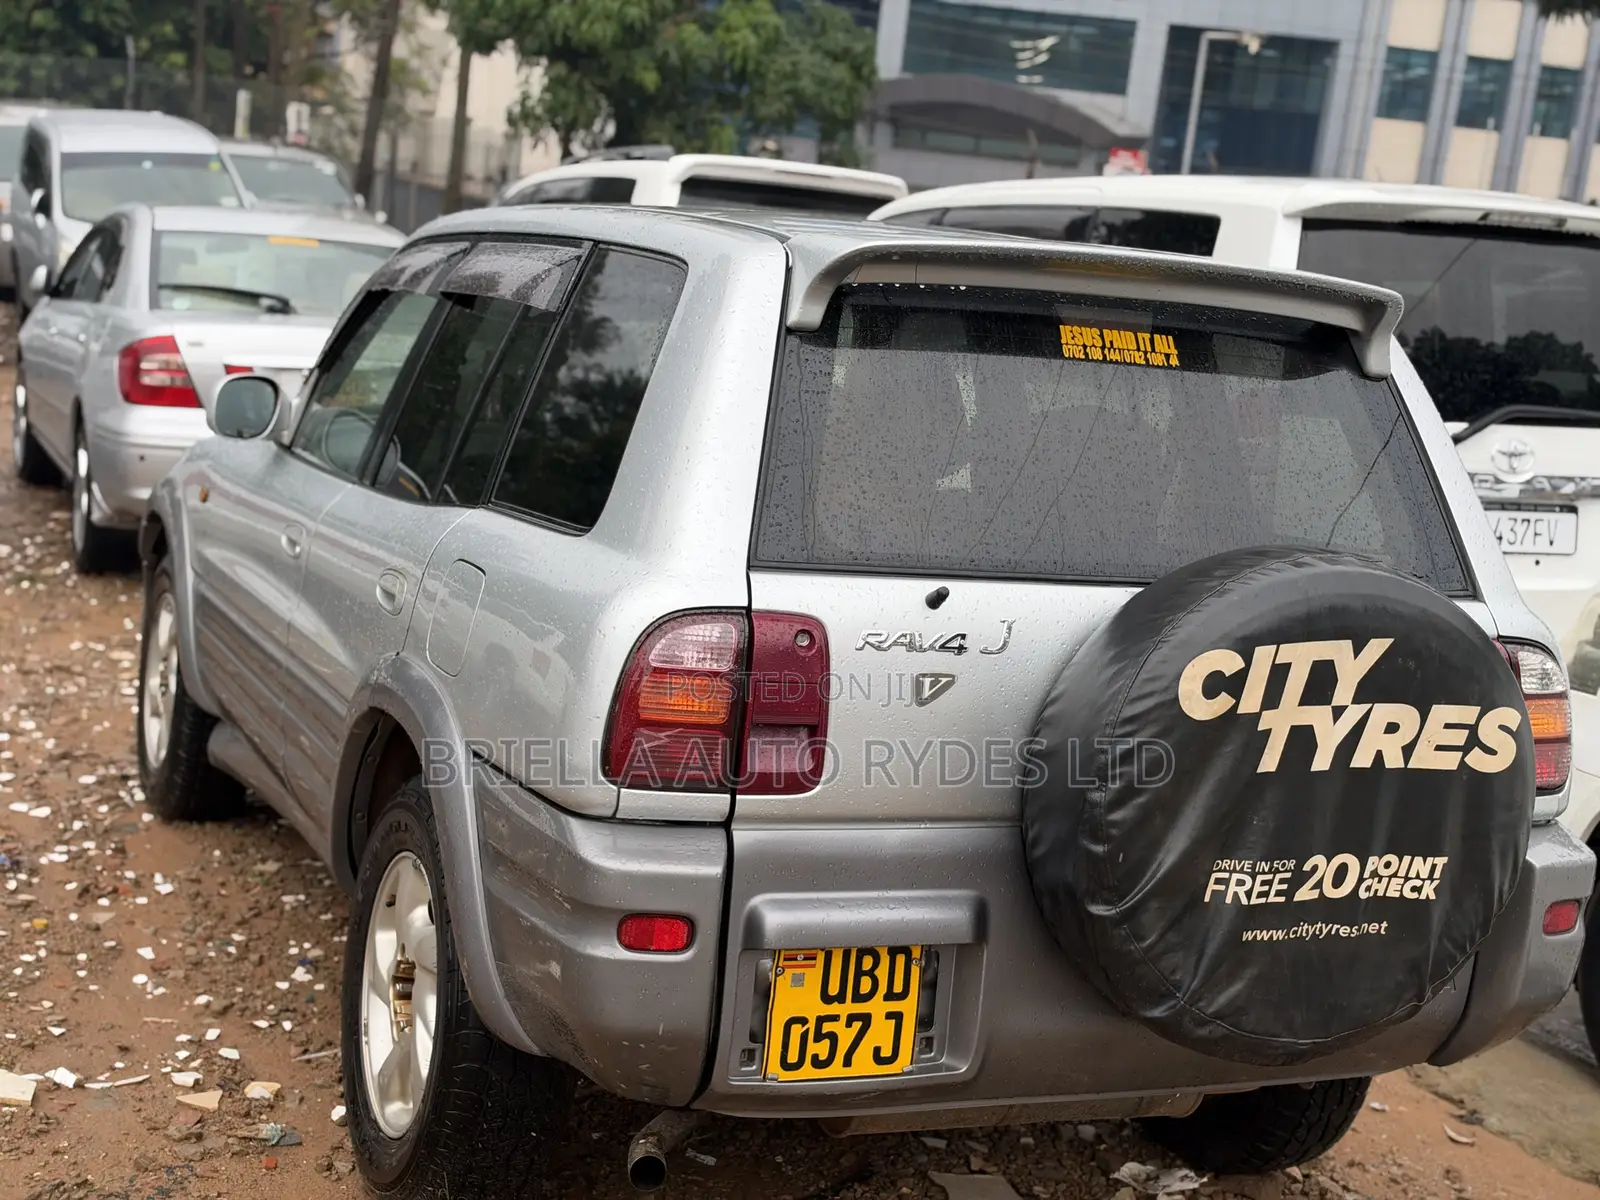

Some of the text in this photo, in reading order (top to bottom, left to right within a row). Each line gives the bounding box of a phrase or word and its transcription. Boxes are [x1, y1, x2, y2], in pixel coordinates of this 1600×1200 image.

[1059, 325, 1178, 354] JESUS PAID IT ALL
[1086, 346, 1103, 360] 108
[855, 618, 1016, 656] RAV4 J
[1178, 638, 1395, 721] CITY
[1257, 702, 1522, 774] TYRES
[1203, 853, 1361, 905] FREE 20
[1213, 859, 1296, 873] DRIVE IN FOR
[1363, 853, 1449, 879] POINT
[1358, 877, 1441, 900] CHECK
[1241, 920, 1388, 942] www.citytyres.net
[820, 946, 912, 1005] UBD
[779, 1010, 904, 1072] 057J
